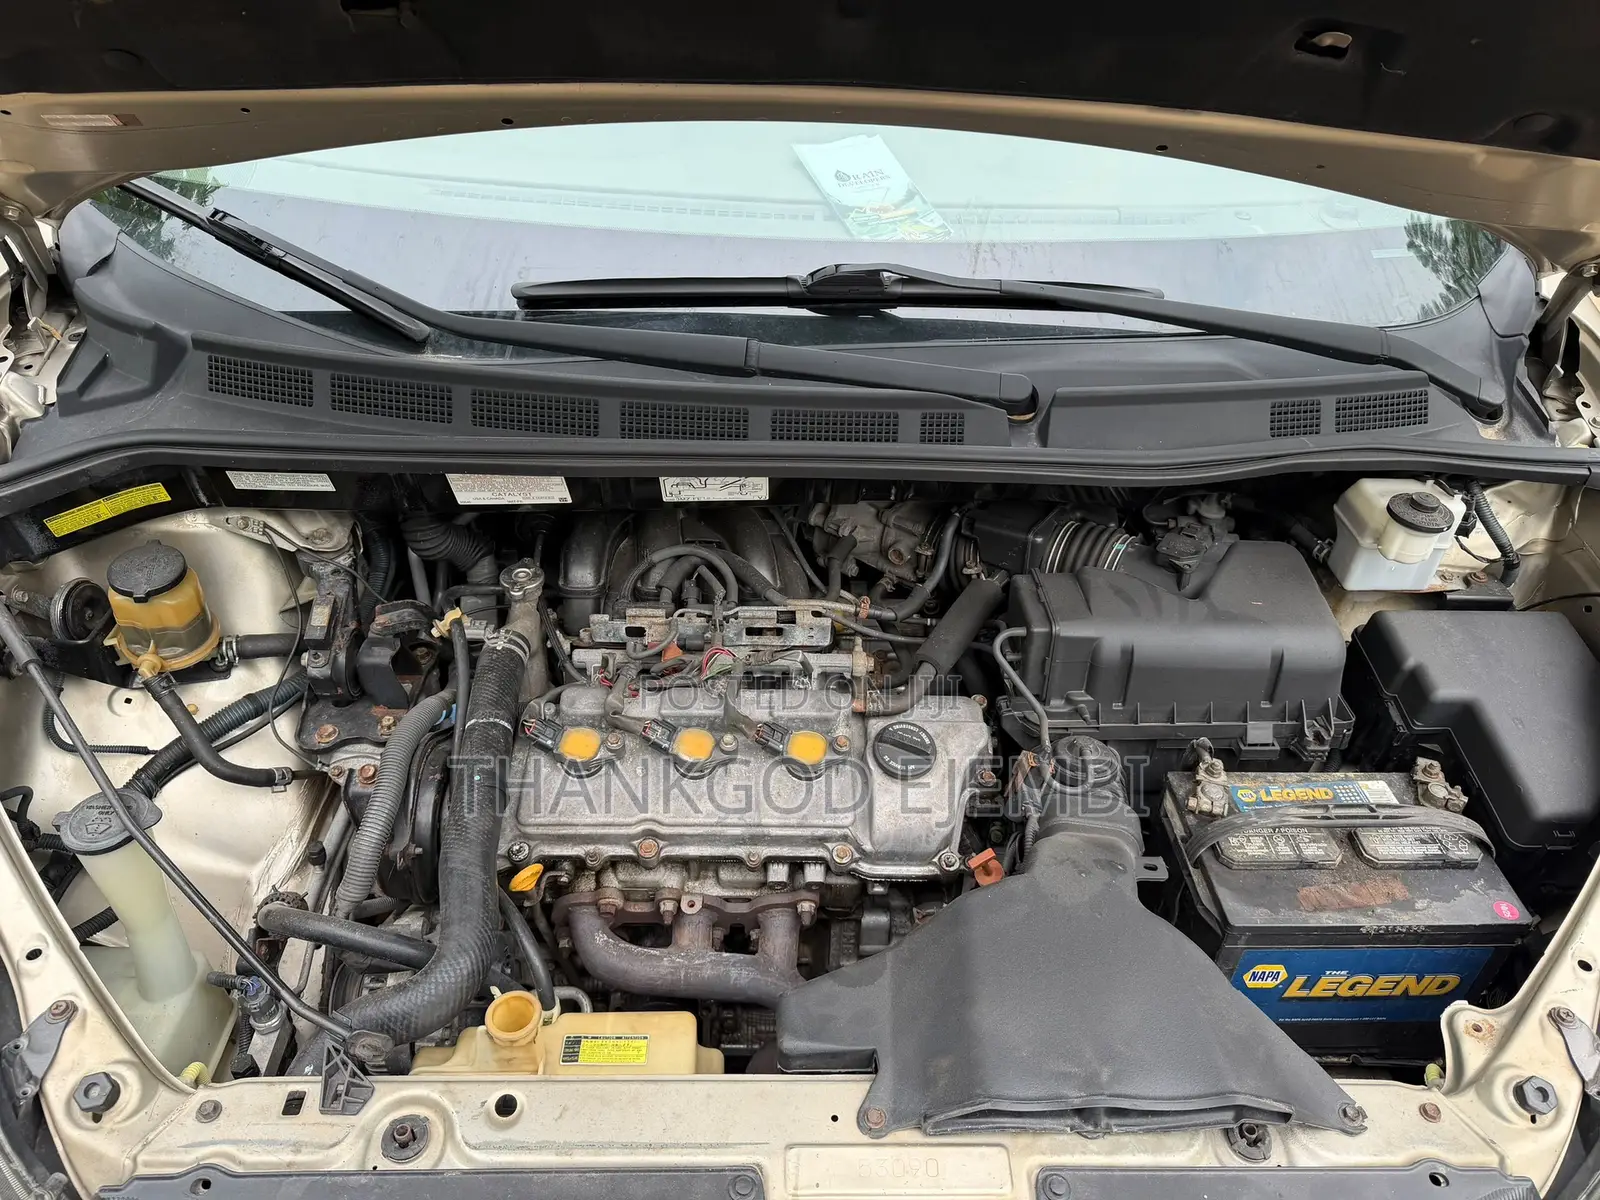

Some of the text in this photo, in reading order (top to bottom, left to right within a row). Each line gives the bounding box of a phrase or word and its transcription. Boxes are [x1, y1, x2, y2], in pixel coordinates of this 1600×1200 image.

[1260, 788, 1335, 802] LEGEND
[1249, 970, 1461, 999] NAPA LEGEND
[857, 1157, 940, 1178] 53090
